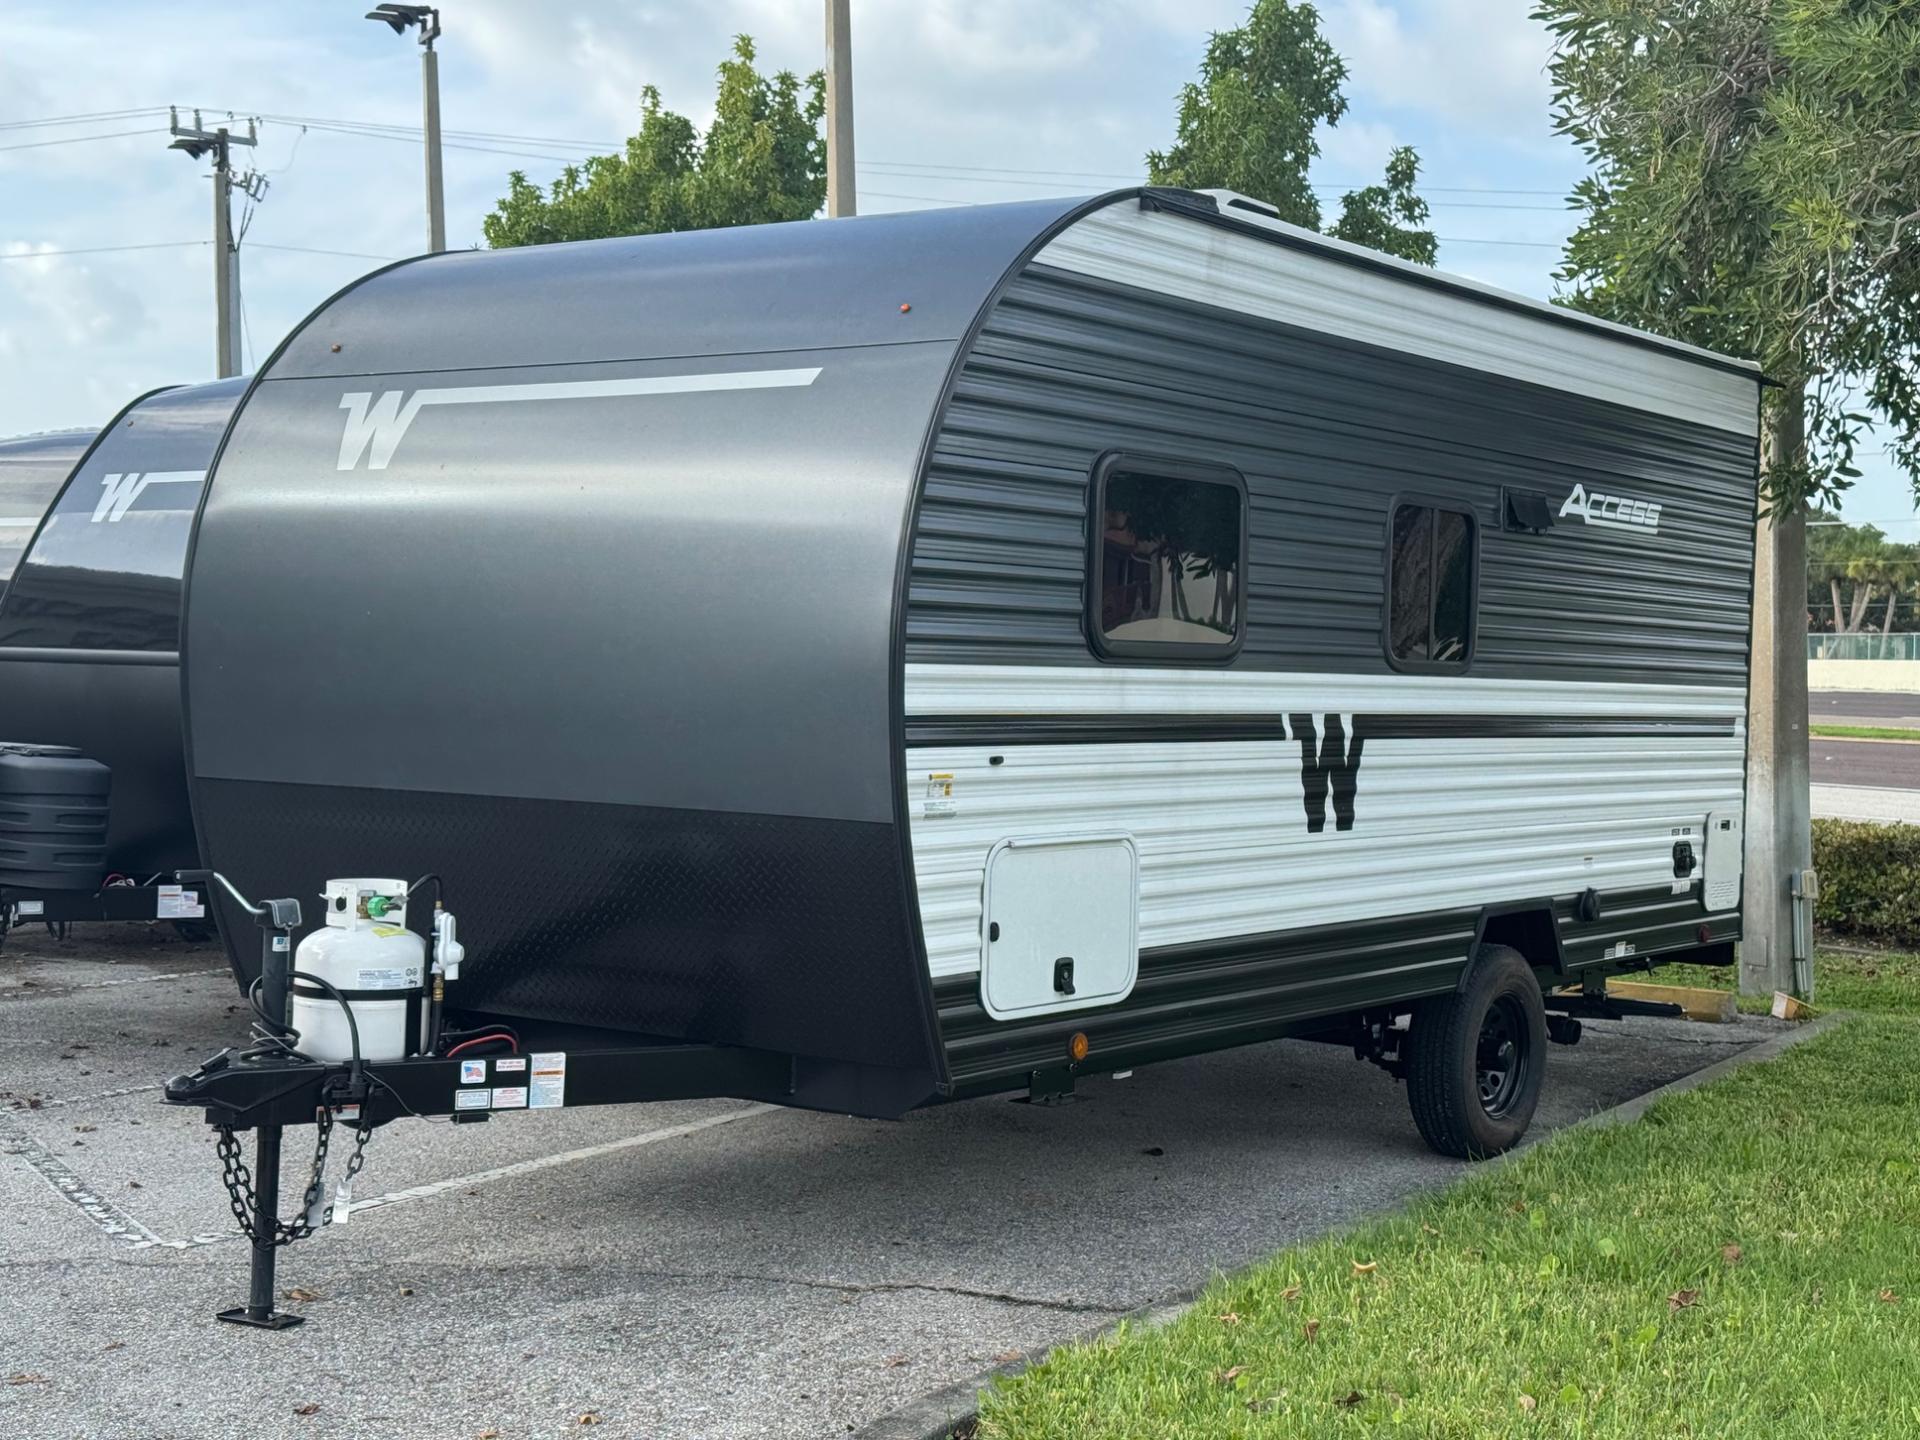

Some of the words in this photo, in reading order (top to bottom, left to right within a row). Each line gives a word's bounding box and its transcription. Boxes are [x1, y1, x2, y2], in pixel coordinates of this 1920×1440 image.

[336, 390, 424, 471] W
[90, 472, 149, 522] W
[1559, 483, 1662, 535] ACCESS
[1287, 713, 1365, 834] W
